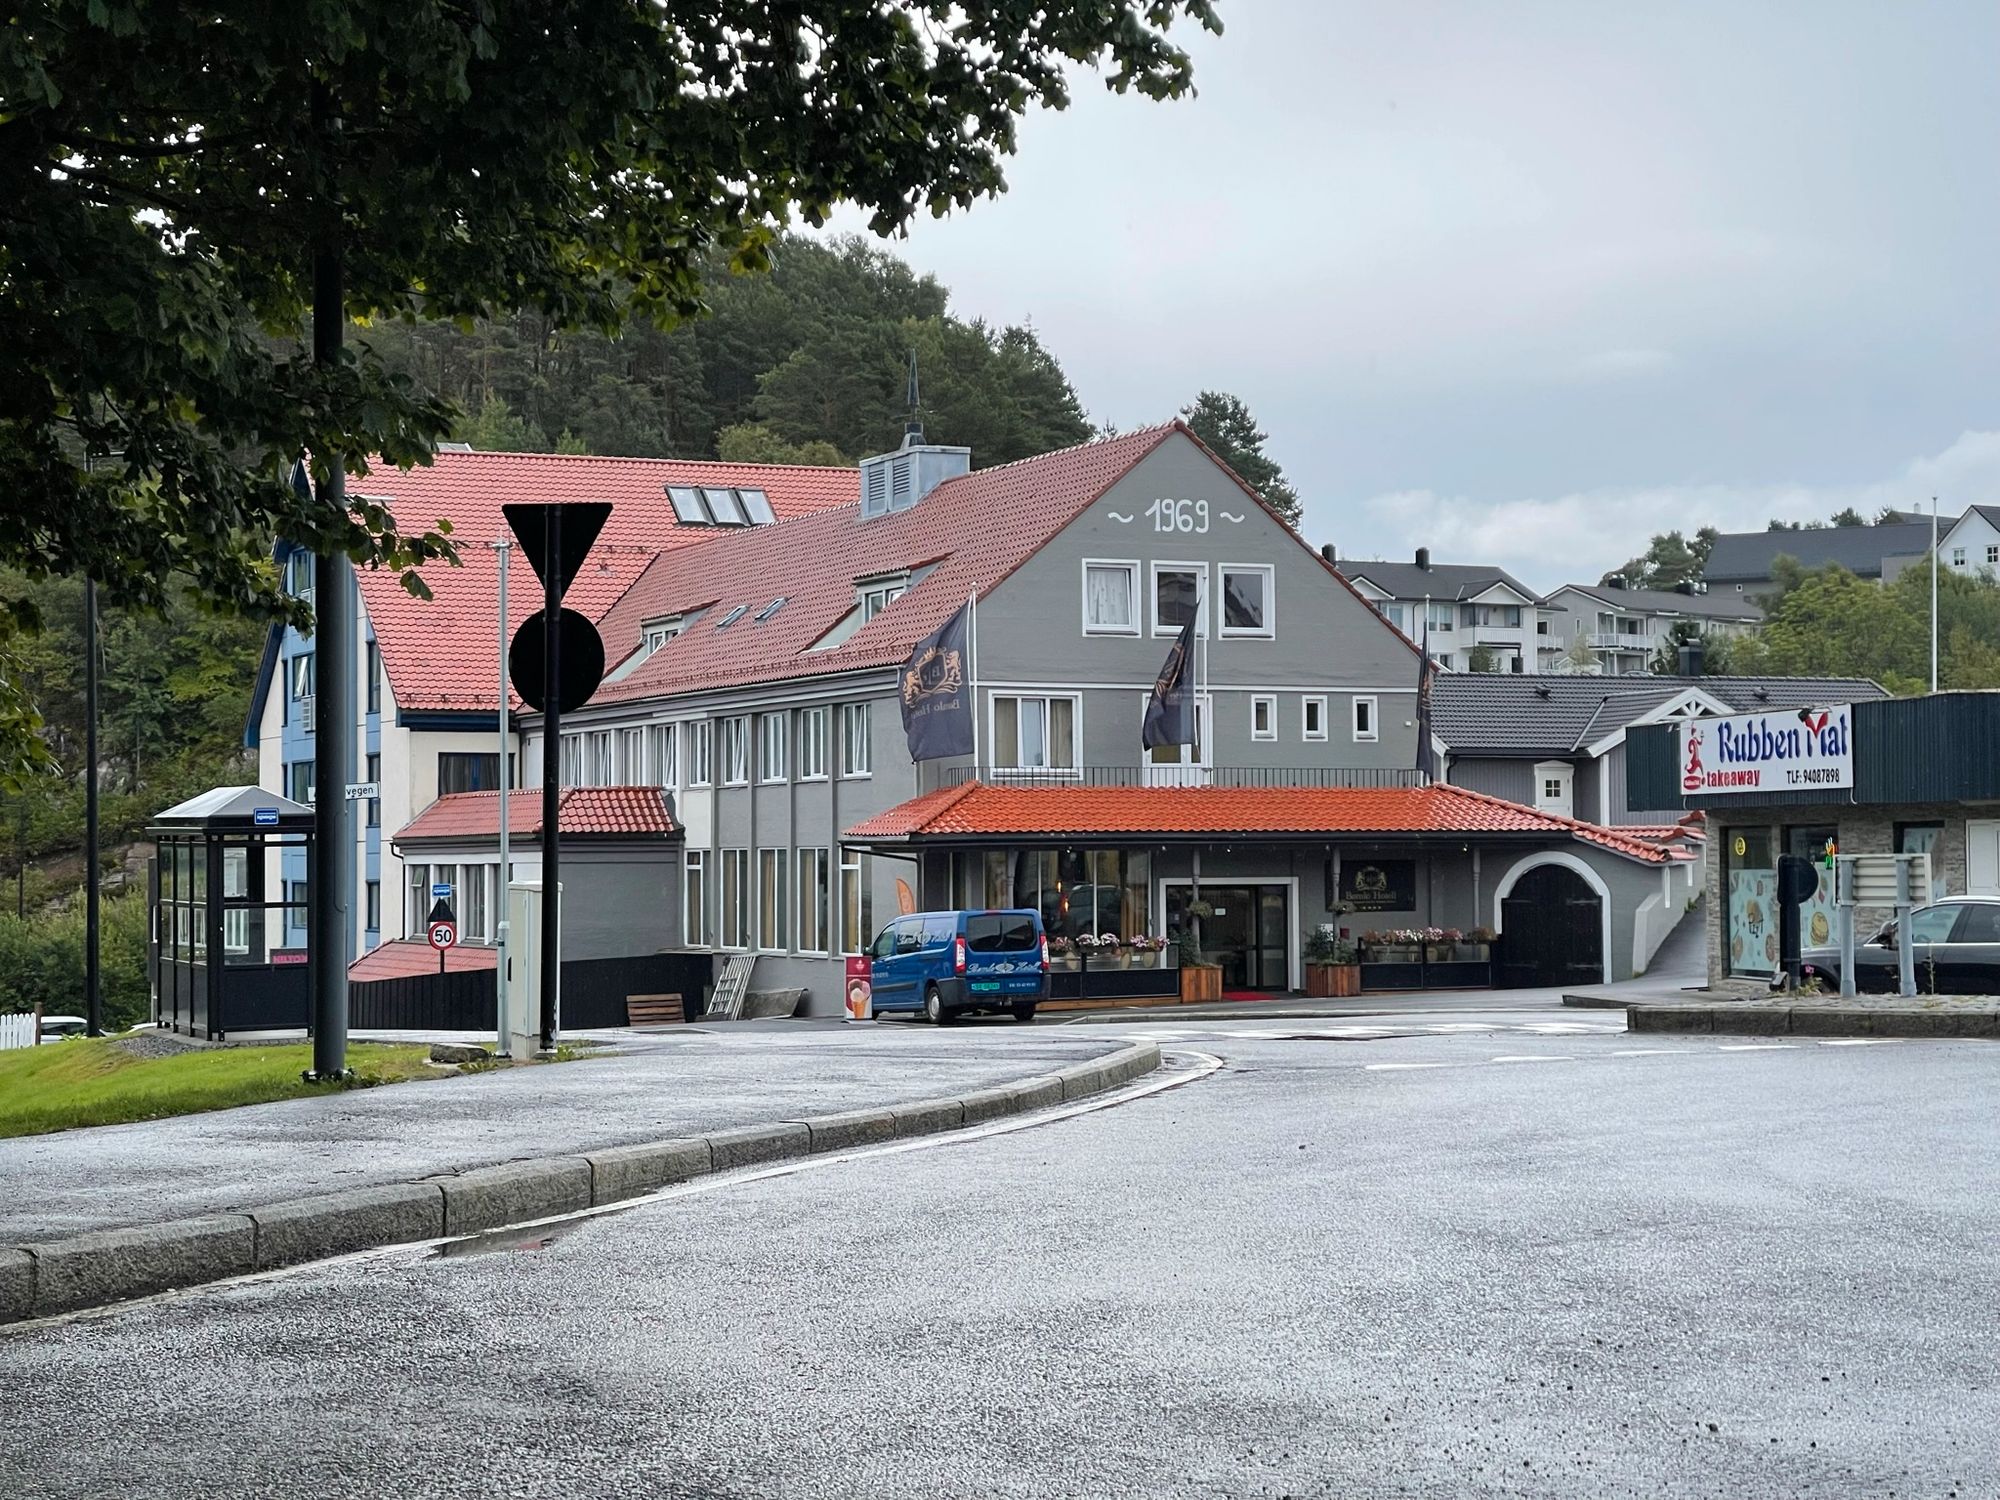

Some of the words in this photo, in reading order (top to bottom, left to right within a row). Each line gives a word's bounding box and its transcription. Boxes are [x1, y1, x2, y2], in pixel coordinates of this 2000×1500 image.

[1144, 498, 1210, 534] 1969
[1718, 718, 1800, 763] Rubben
[1803, 711, 1848, 758] Mat
[1706, 769, 1760, 787] takeaway
[1787, 770, 1802, 784] TLF:
[1803, 768, 1840, 784] 94087898
[345, 786, 374, 797] vegen
[434, 929, 452, 943] 50
